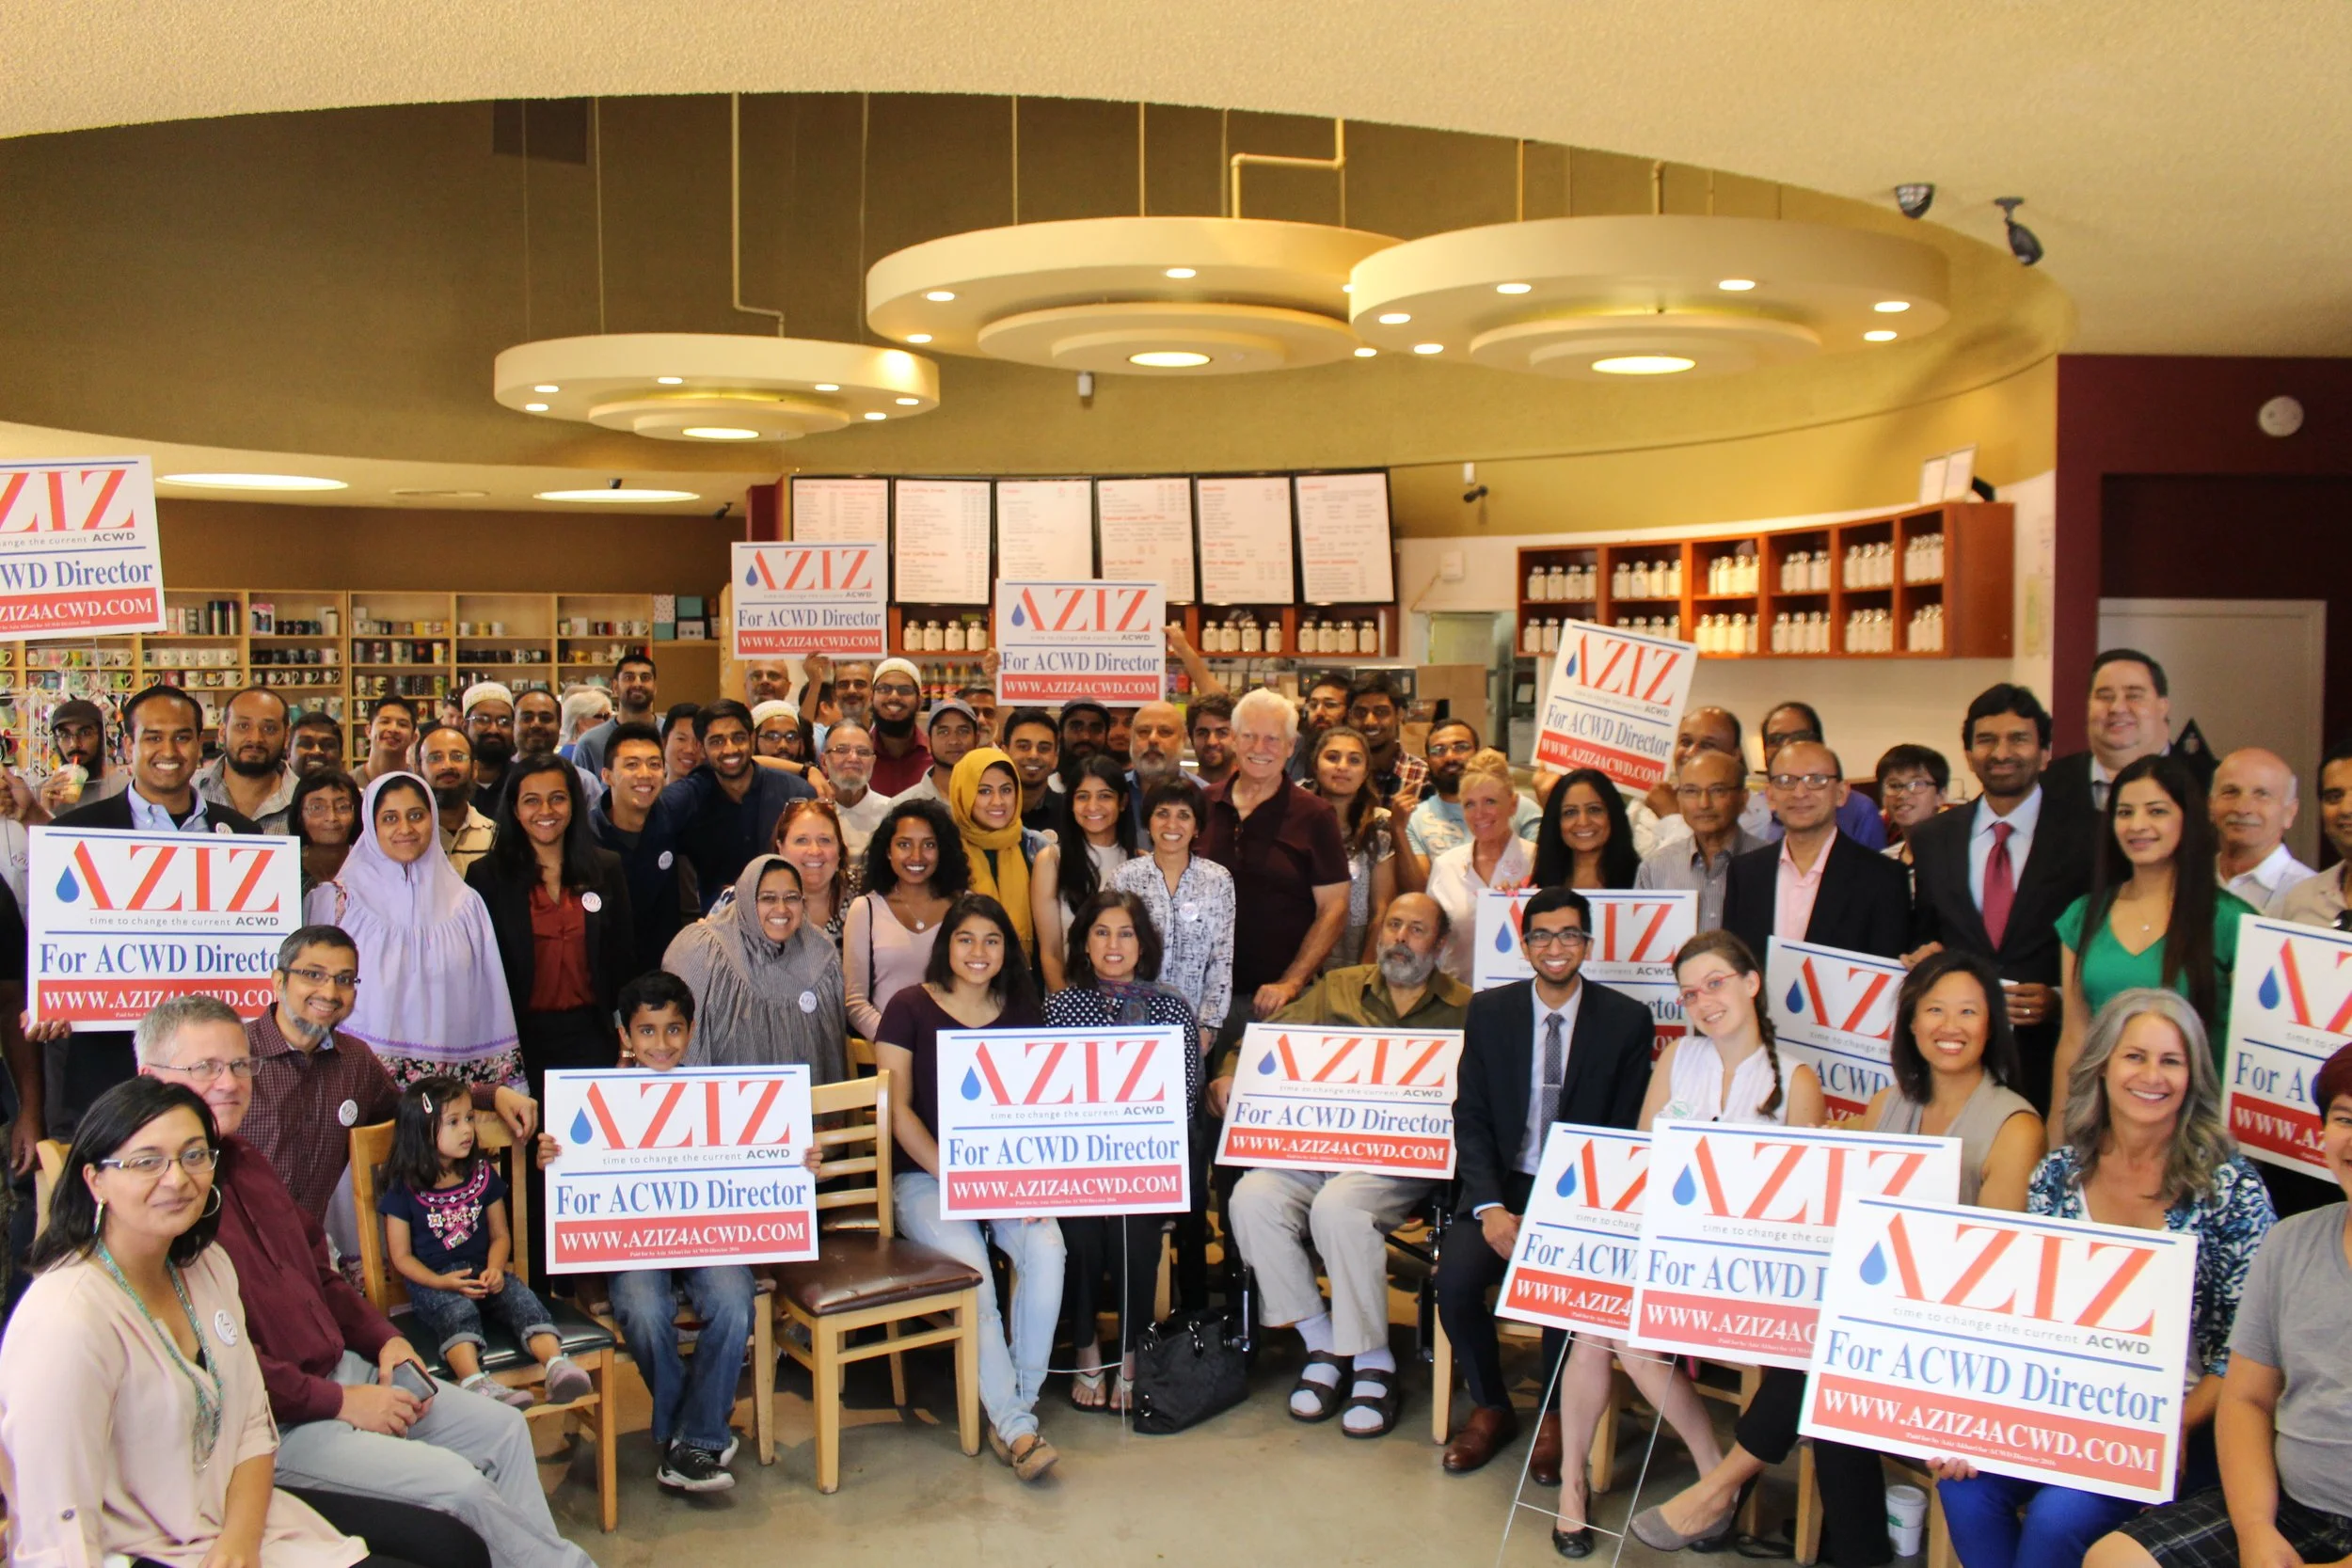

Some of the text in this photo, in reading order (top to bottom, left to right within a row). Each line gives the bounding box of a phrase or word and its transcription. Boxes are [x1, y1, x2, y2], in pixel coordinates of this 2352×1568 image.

[0, 469, 135, 533] ZIZ
[92, 531, 135, 542] ACWD
[0, 560, 152, 590] WD Director
[754, 548, 871, 590] AZIZ
[738, 609, 881, 626] For ACWD Director
[1021, 586, 1151, 631] AZIZ
[740, 636, 879, 646] WWW.AZIZ4ACWD.COM
[1002, 651, 1159, 671] For ACWD Director
[1578, 632, 1681, 705] AZIZ
[1005, 681, 1157, 693] WWW.AZIZ4ACWD.COM
[1546, 704, 1672, 756] For ACWD Director
[73, 839, 278, 912] AZIZ
[88, 916, 113, 925] time
[131, 916, 167, 927] change
[170, 917, 187, 926] the
[235, 916, 278, 926] ACWD
[40, 942, 278, 973] For ACWD Directo
[1636, 967, 1674, 975] ACWD
[975, 1039, 1164, 1106] AZIZ
[1277, 1033, 1447, 1088] AZIZ
[2234, 1051, 2280, 1095] For
[586, 1079, 789, 1150] AZIZ
[1027, 1110, 1059, 1119] change
[1063, 1109, 1078, 1117] the
[1123, 1105, 1164, 1115] ACWD
[1232, 1101, 1452, 1133] For ACWD Director
[643, 1154, 678, 1164] change
[682, 1153, 698, 1162] the
[746, 1148, 789, 1159] ACWD
[948, 1133, 1179, 1165] For ACWD Director
[1232, 1135, 1444, 1160] WWW.AZIZ4ACWD.COM
[556, 1179, 806, 1214] For ACWD Director
[953, 1175, 1178, 1197] WWW.AZIZ4ACWD.COM
[561, 1222, 805, 1249] WWW.AZIZ4ACWD.COM
[1702, 1223, 1727, 1233] time
[1732, 1227, 1743, 1235] to
[1746, 1227, 1787, 1241] change
[1791, 1230, 1810, 1242] the
[1520, 1233, 1638, 1280] For ACW
[1645, 1248, 1694, 1286] For
[1702, 1255, 1804, 1298] ACWD
[1887, 1211, 2155, 1337] AZIZ
[1893, 1307, 2150, 1354] time to change the current ACWD
[1824, 1329, 2168, 1422] For ACWD Director
[1824, 1388, 2156, 1471] WWW.AZIZ4ACWD.COM
